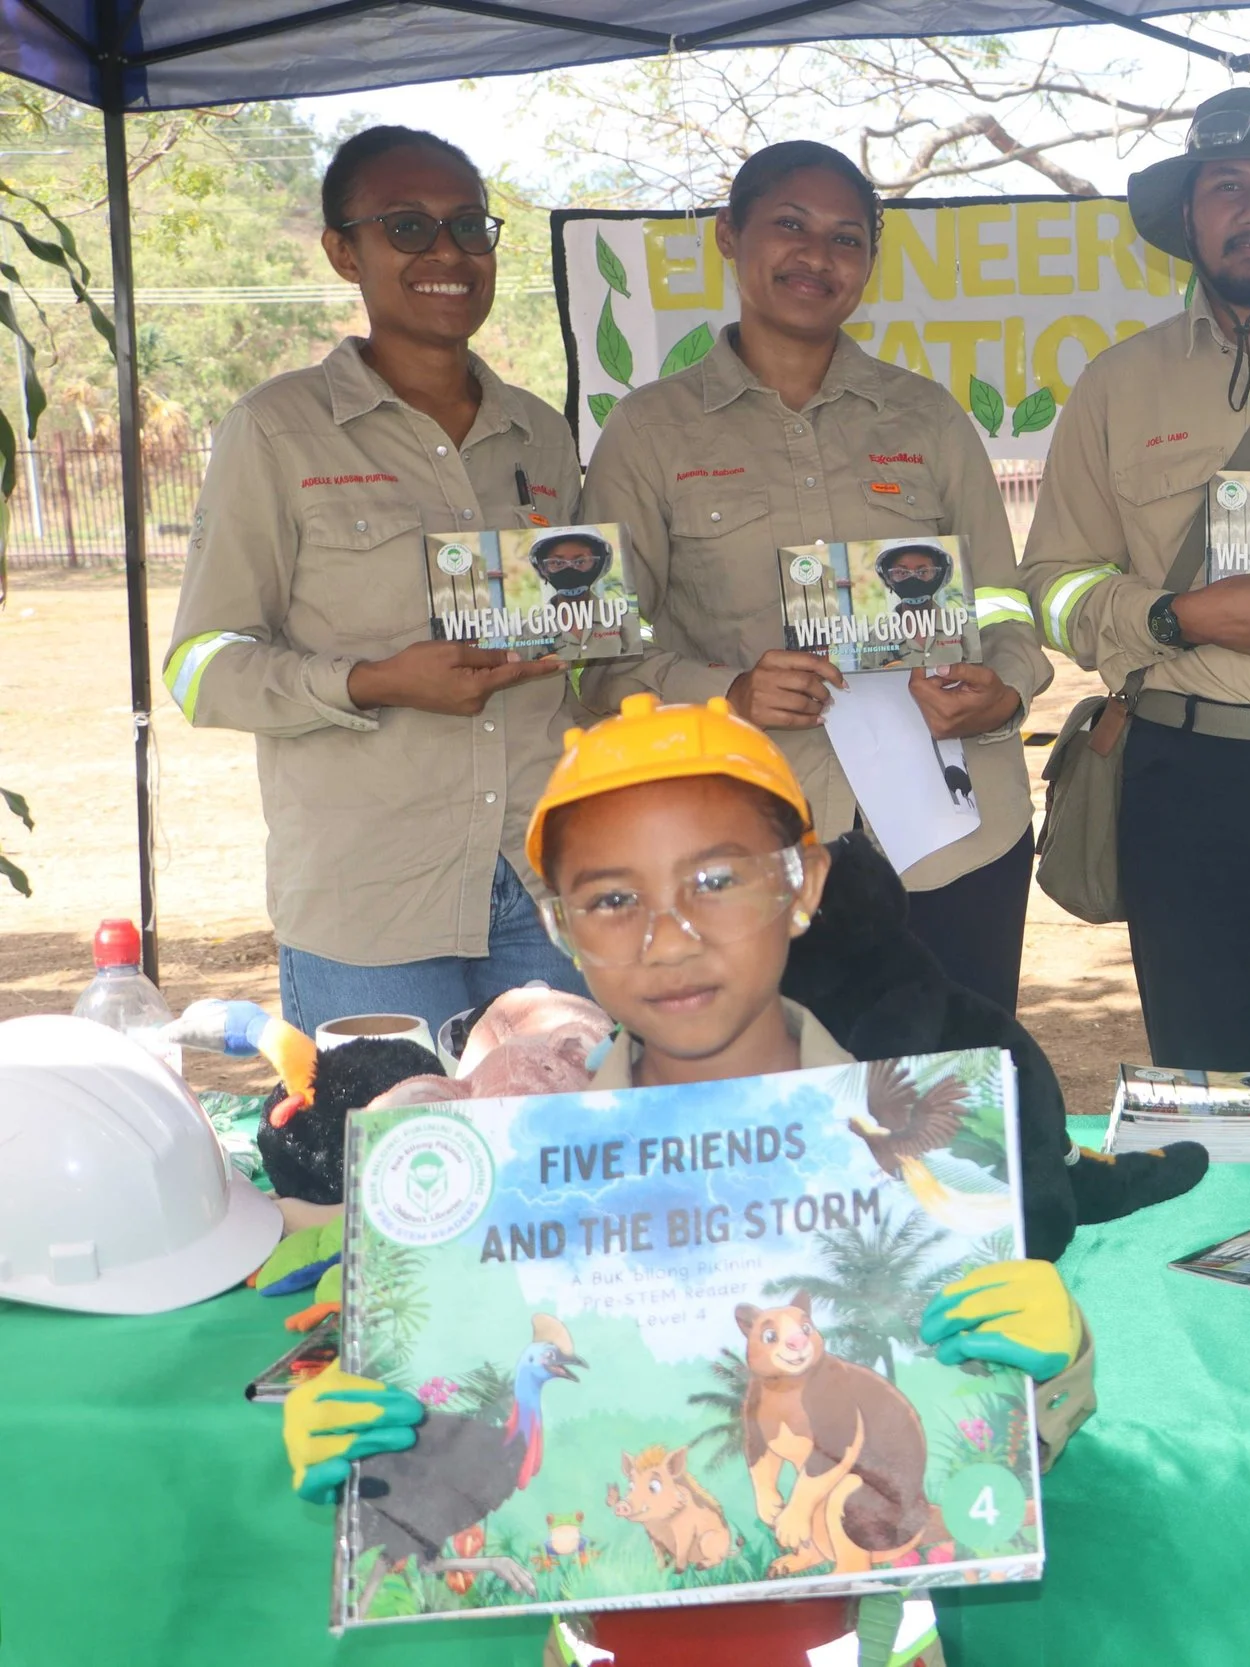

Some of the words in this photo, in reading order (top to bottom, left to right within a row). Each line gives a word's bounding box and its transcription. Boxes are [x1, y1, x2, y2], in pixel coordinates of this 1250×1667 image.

[1146, 435, 1164, 448] JOEL
[442, 606, 509, 641] WHEN
[528, 600, 594, 635] GROW
[599, 597, 629, 628] UP
[794, 614, 858, 647] WHEN
[874, 608, 937, 642] GROW
[941, 607, 969, 636] UP
[539, 1141, 625, 1184] FIVE
[639, 1122, 806, 1176] FRIENDS
[480, 1219, 566, 1264] AND
[579, 1212, 653, 1256] THE
[667, 1205, 730, 1248] BIG
[744, 1187, 881, 1240] STORM
[572, 1274, 582, 1286] A
[634, 1266, 690, 1281] bilong
[583, 1286, 677, 1309] Pre-STEM
[685, 1281, 749, 1299] Reader
[635, 1310, 687, 1328] Level
[695, 1308, 707, 1322] 4
[967, 1484, 1000, 1526] 4
